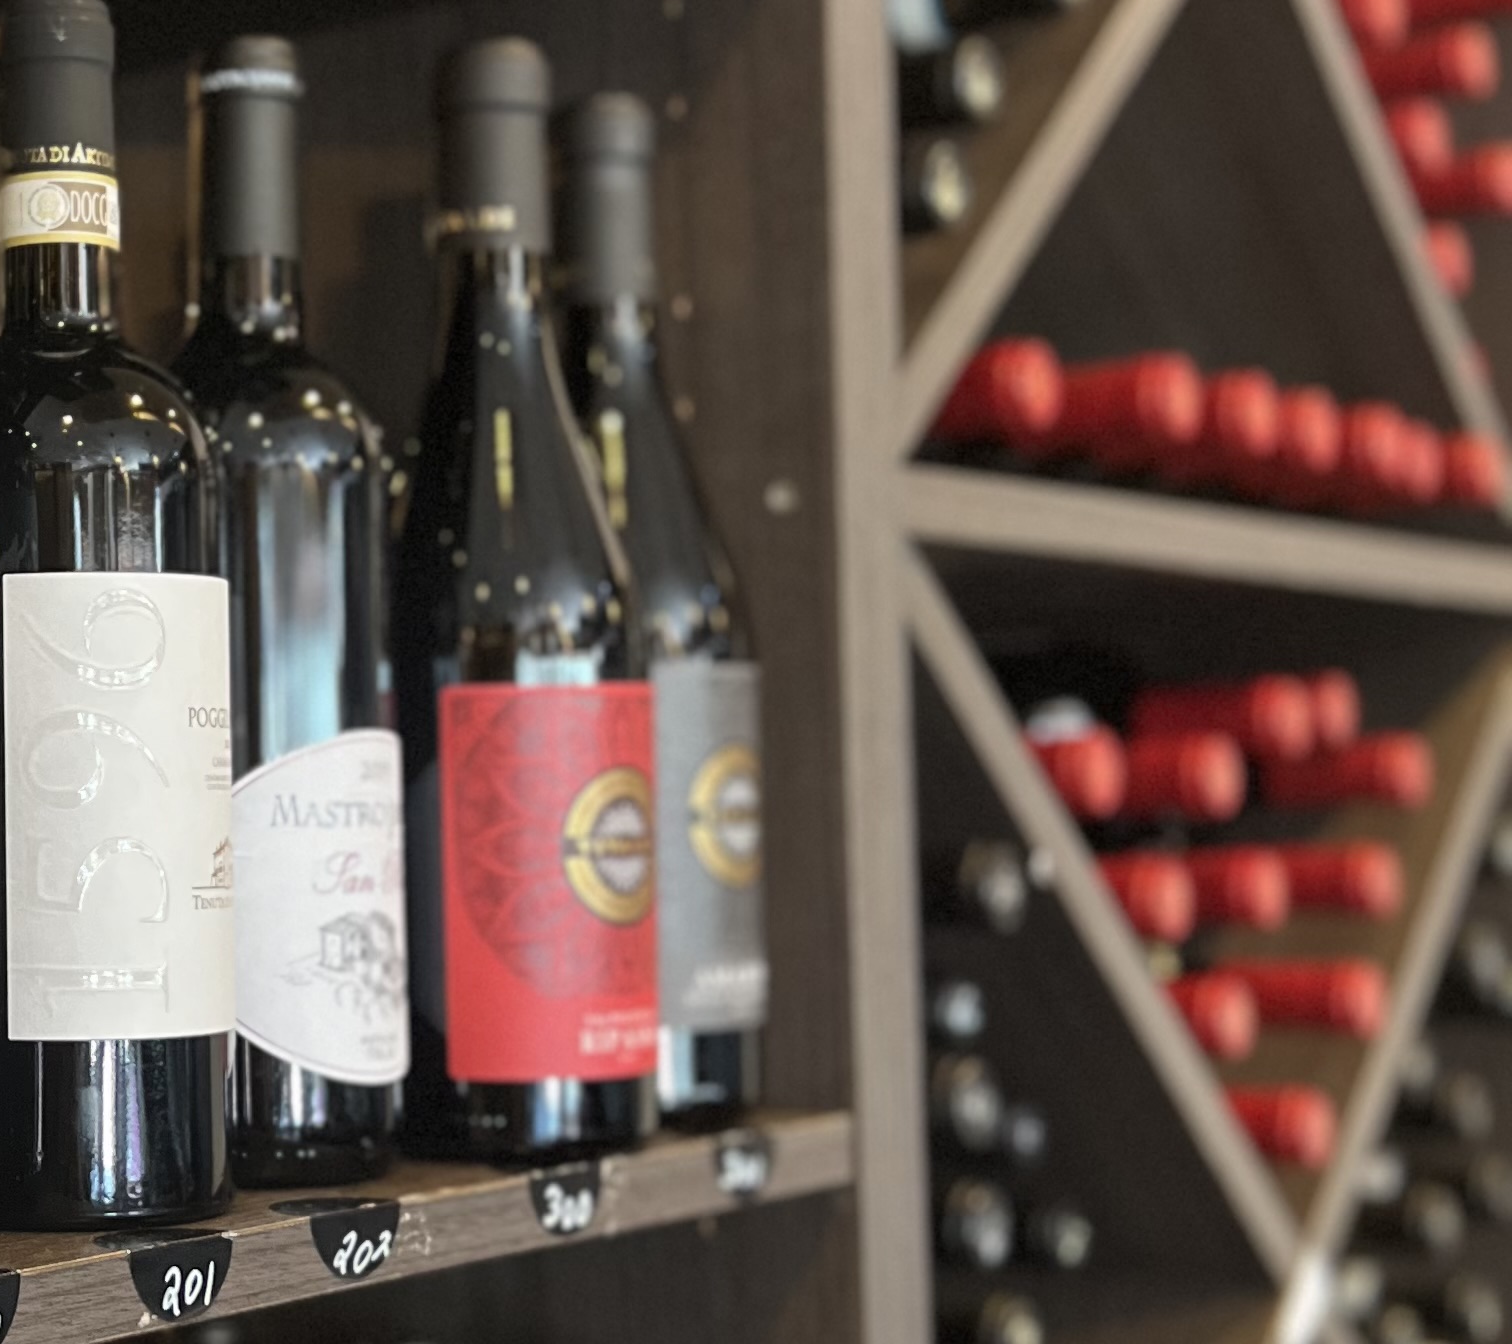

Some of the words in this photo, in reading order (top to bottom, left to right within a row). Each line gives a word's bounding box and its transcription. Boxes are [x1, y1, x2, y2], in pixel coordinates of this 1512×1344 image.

[70, 189, 108, 227] DOCG
[333, 1230, 394, 1278] 202
[161, 1261, 215, 1318] 201
